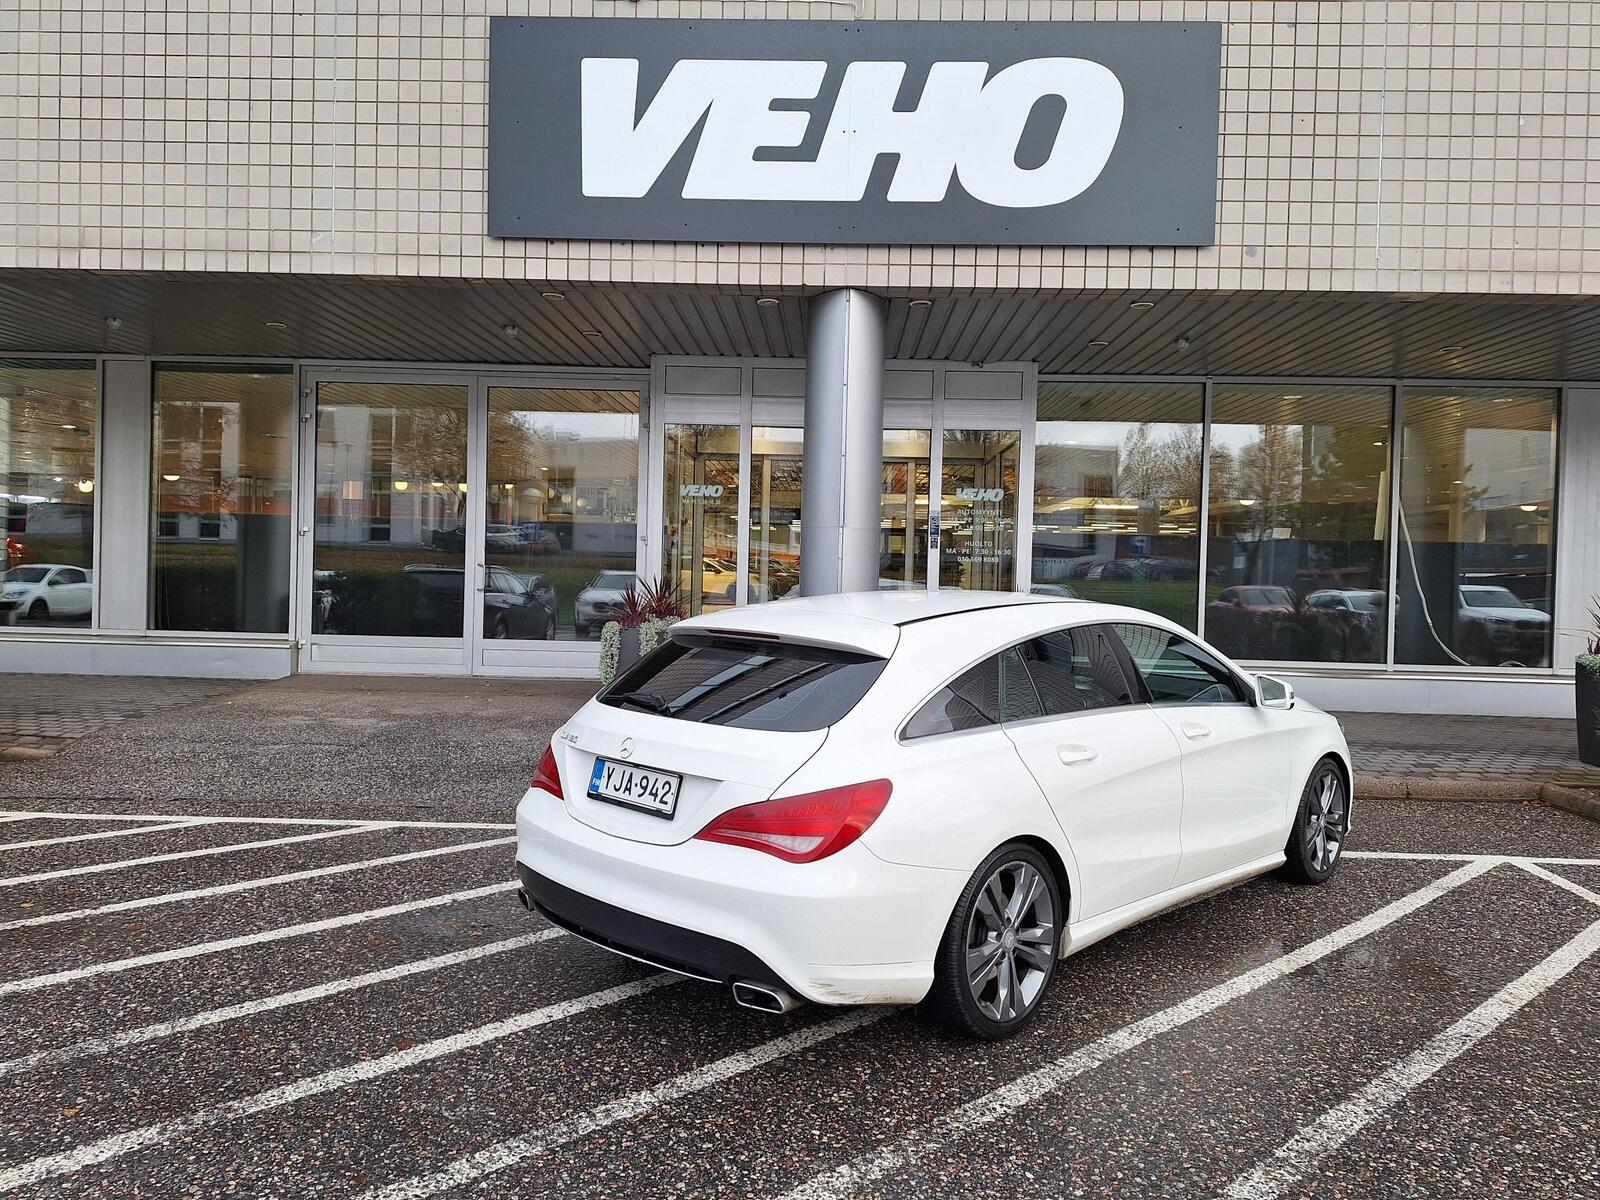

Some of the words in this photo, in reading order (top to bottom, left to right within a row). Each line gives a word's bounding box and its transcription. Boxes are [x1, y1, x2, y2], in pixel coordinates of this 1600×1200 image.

[581, 57, 1124, 208] VEHO
[680, 484, 724, 498] VEHO
[956, 488, 1004, 502] VEHO
[957, 509, 1002, 517] AUTOMYYNTI
